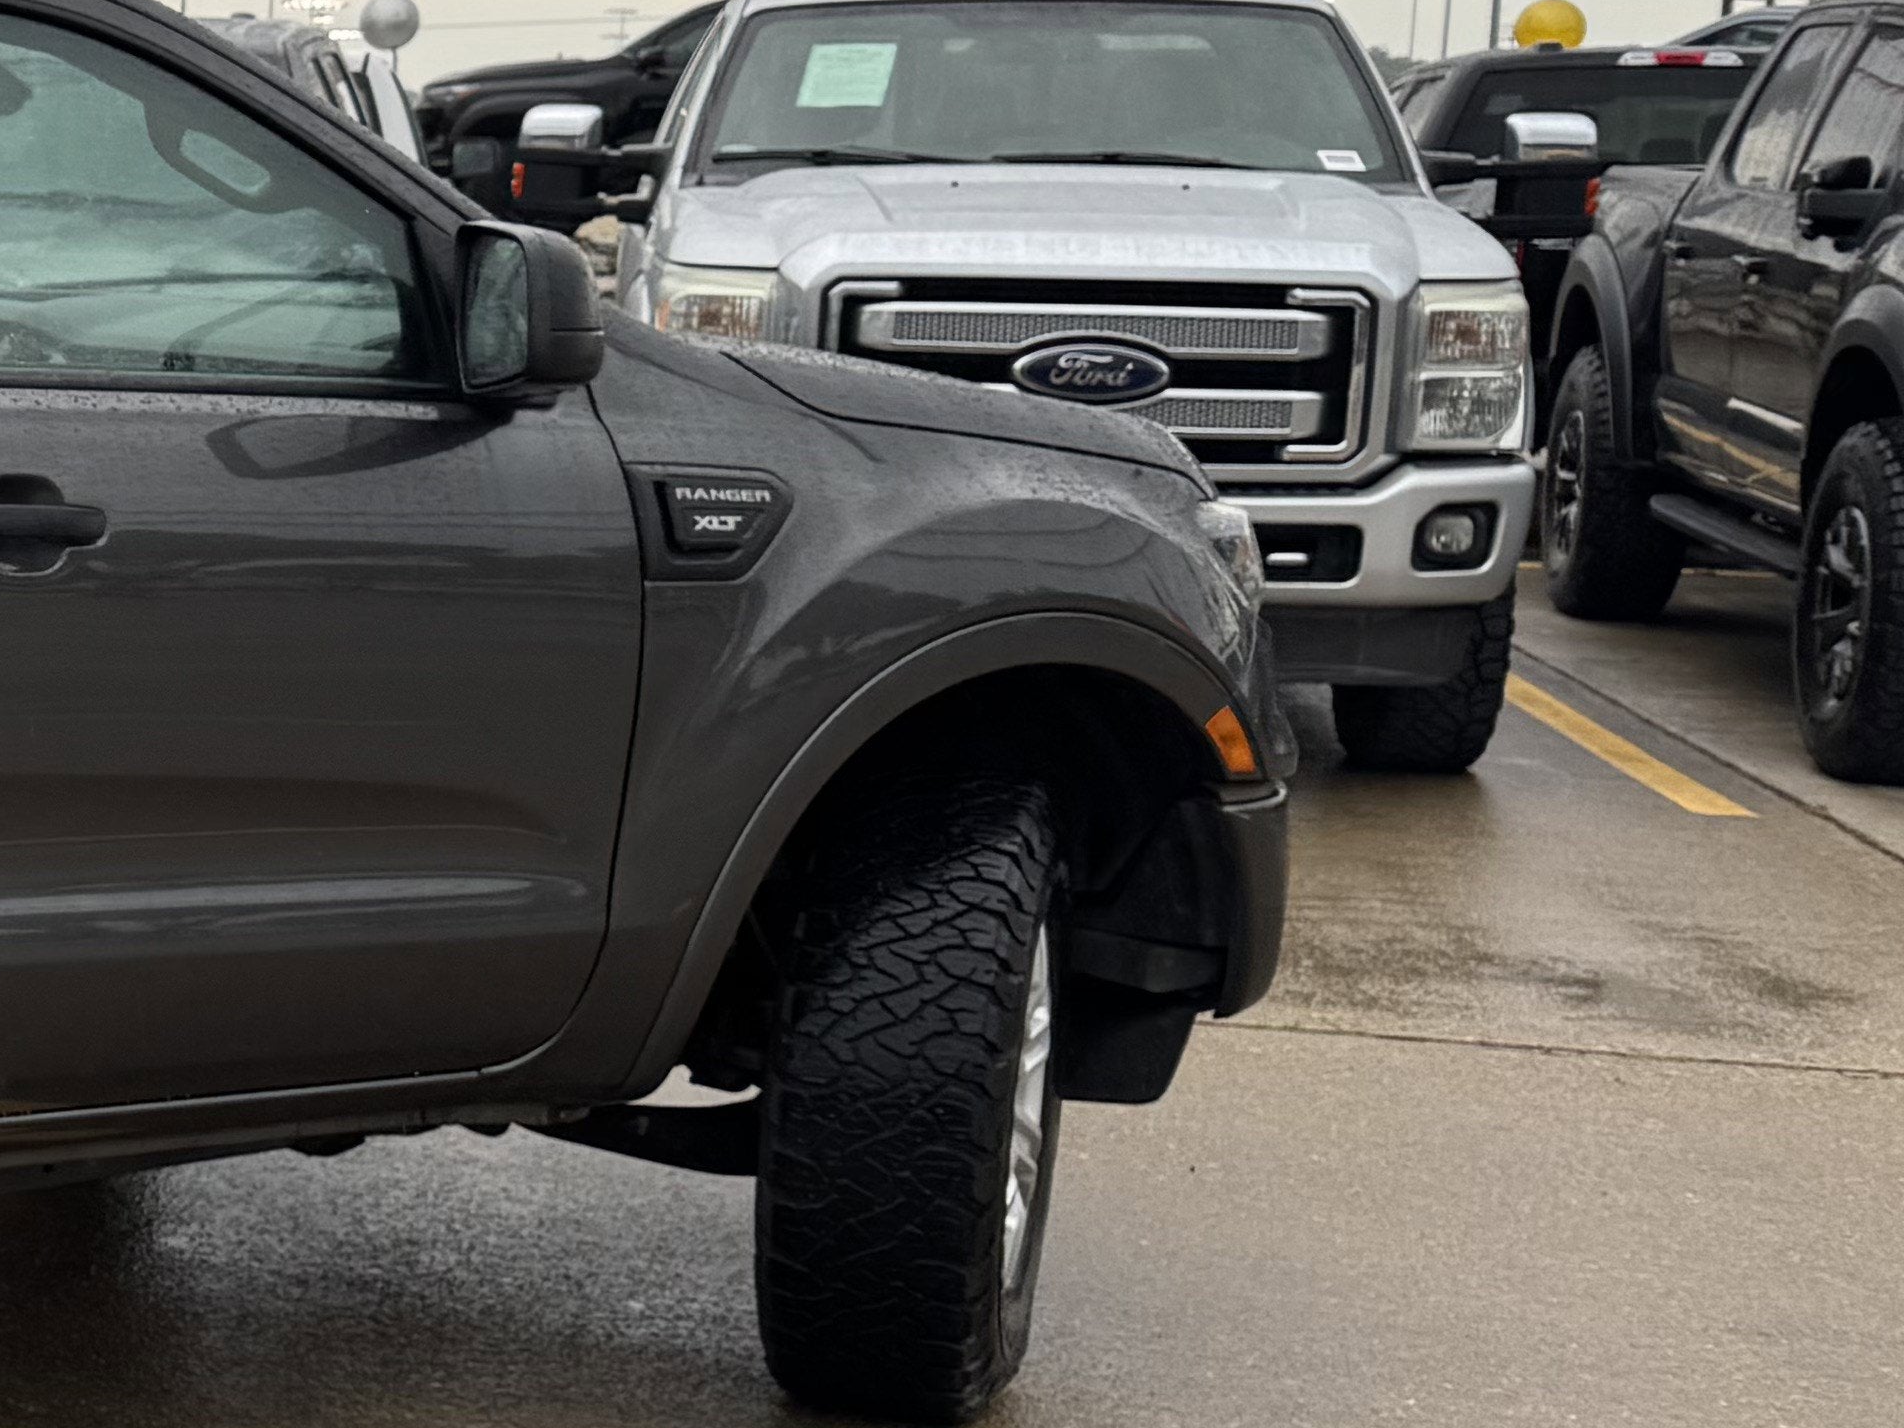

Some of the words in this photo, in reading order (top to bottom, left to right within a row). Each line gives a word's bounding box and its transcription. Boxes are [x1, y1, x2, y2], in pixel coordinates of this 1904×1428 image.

[1049, 351, 1135, 387] Ford
[674, 486, 772, 503] RANGER
[693, 514, 743, 531] XLT
